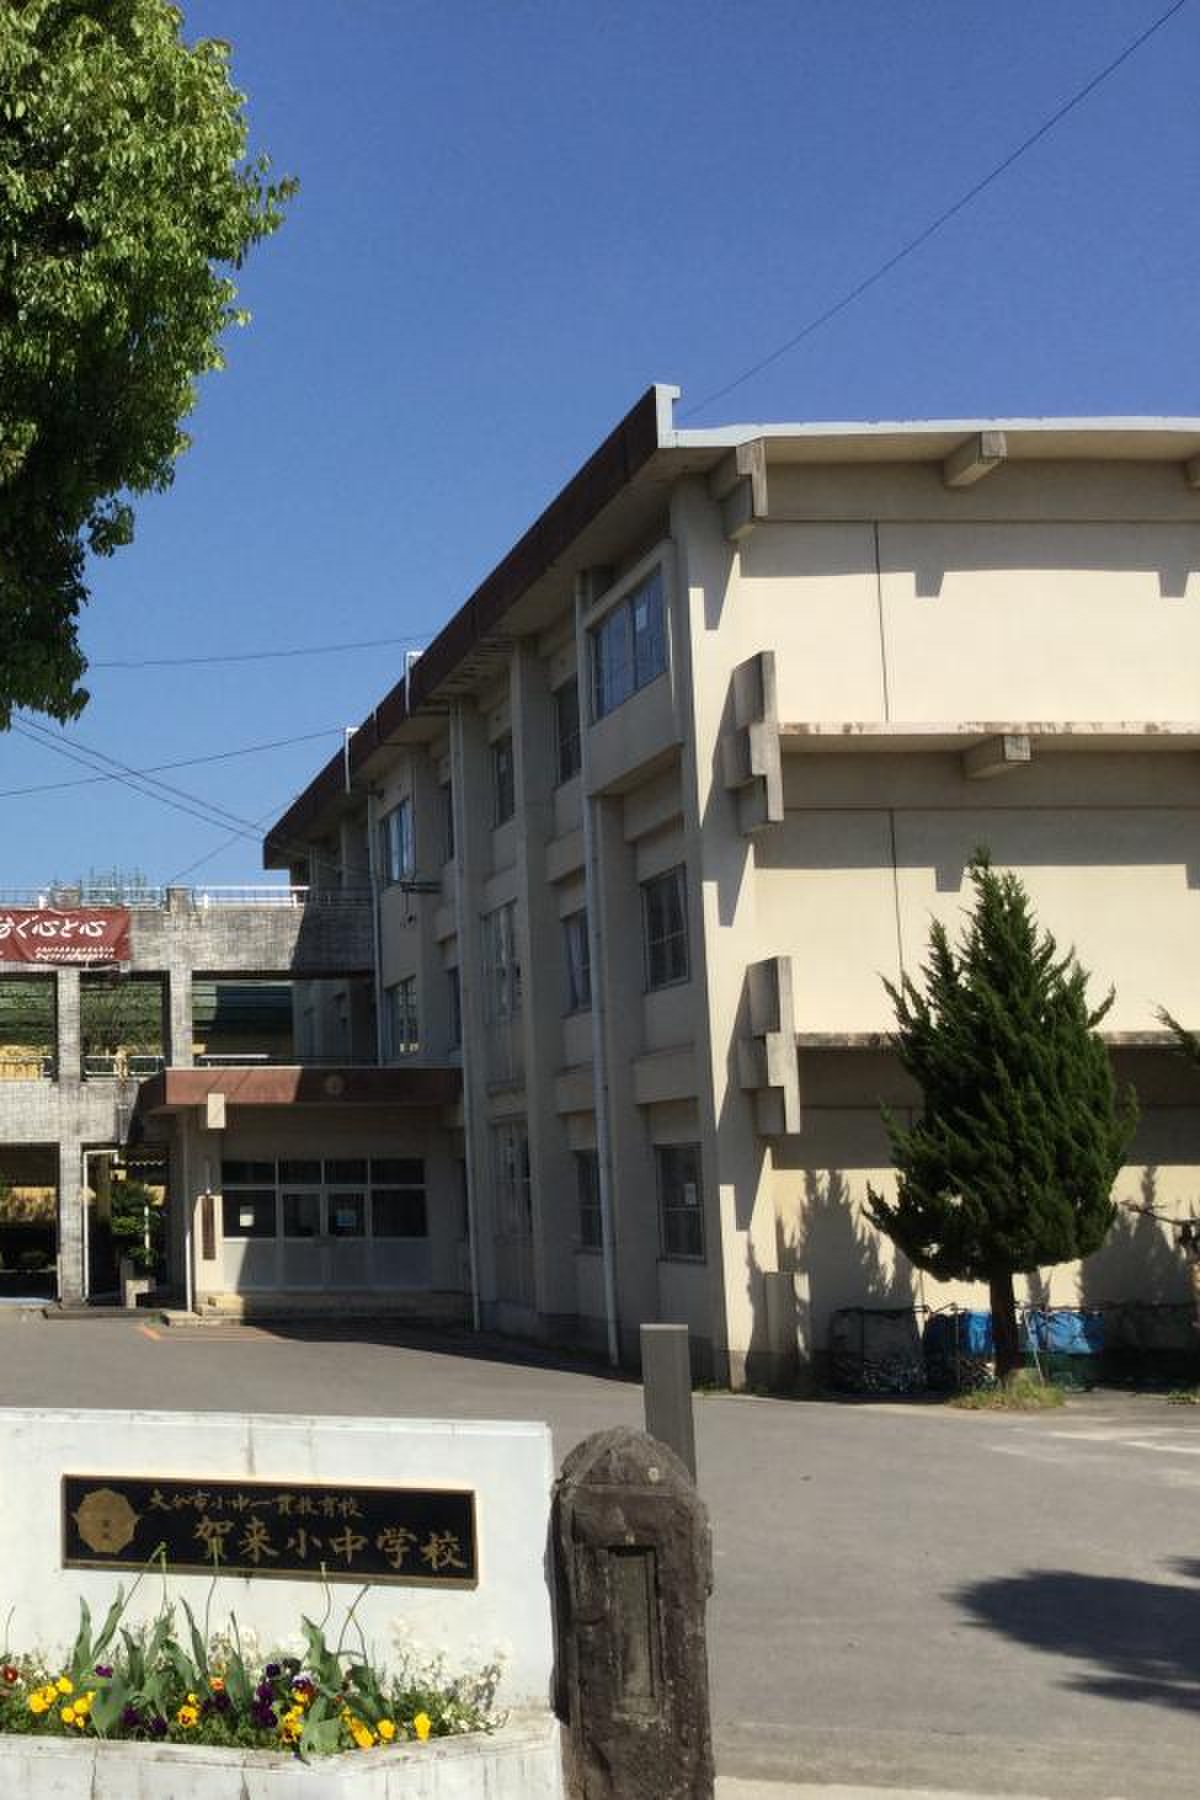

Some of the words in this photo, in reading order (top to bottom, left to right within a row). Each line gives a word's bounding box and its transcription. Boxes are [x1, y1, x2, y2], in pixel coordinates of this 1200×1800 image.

[193, 1515, 468, 1570] 賀来小中学校
